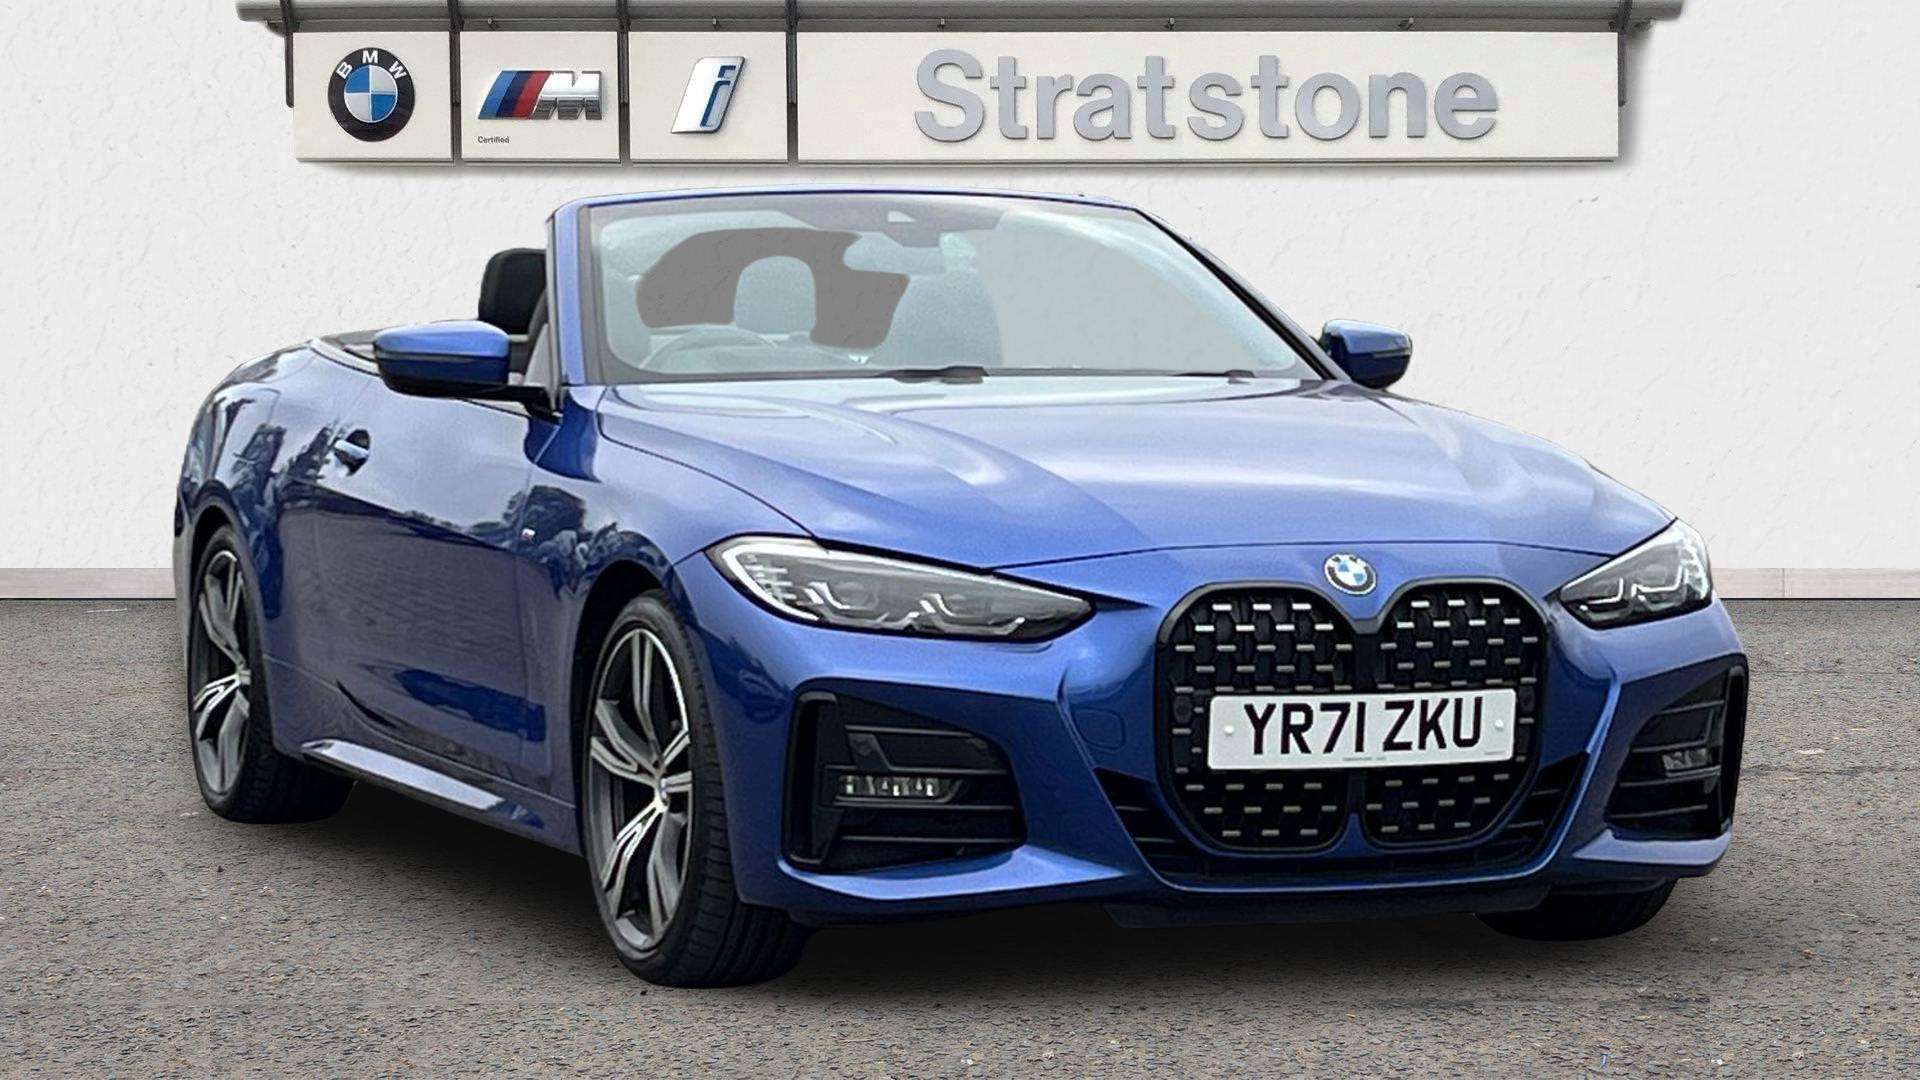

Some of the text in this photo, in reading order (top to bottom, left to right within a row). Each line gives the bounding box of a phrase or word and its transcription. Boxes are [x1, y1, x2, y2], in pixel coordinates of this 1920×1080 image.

[335, 50, 407, 80] BMW
[914, 48, 1500, 142] Stratstone
[477, 135, 510, 144] Certified
[1243, 696, 1484, 755] YR71 ZKU
